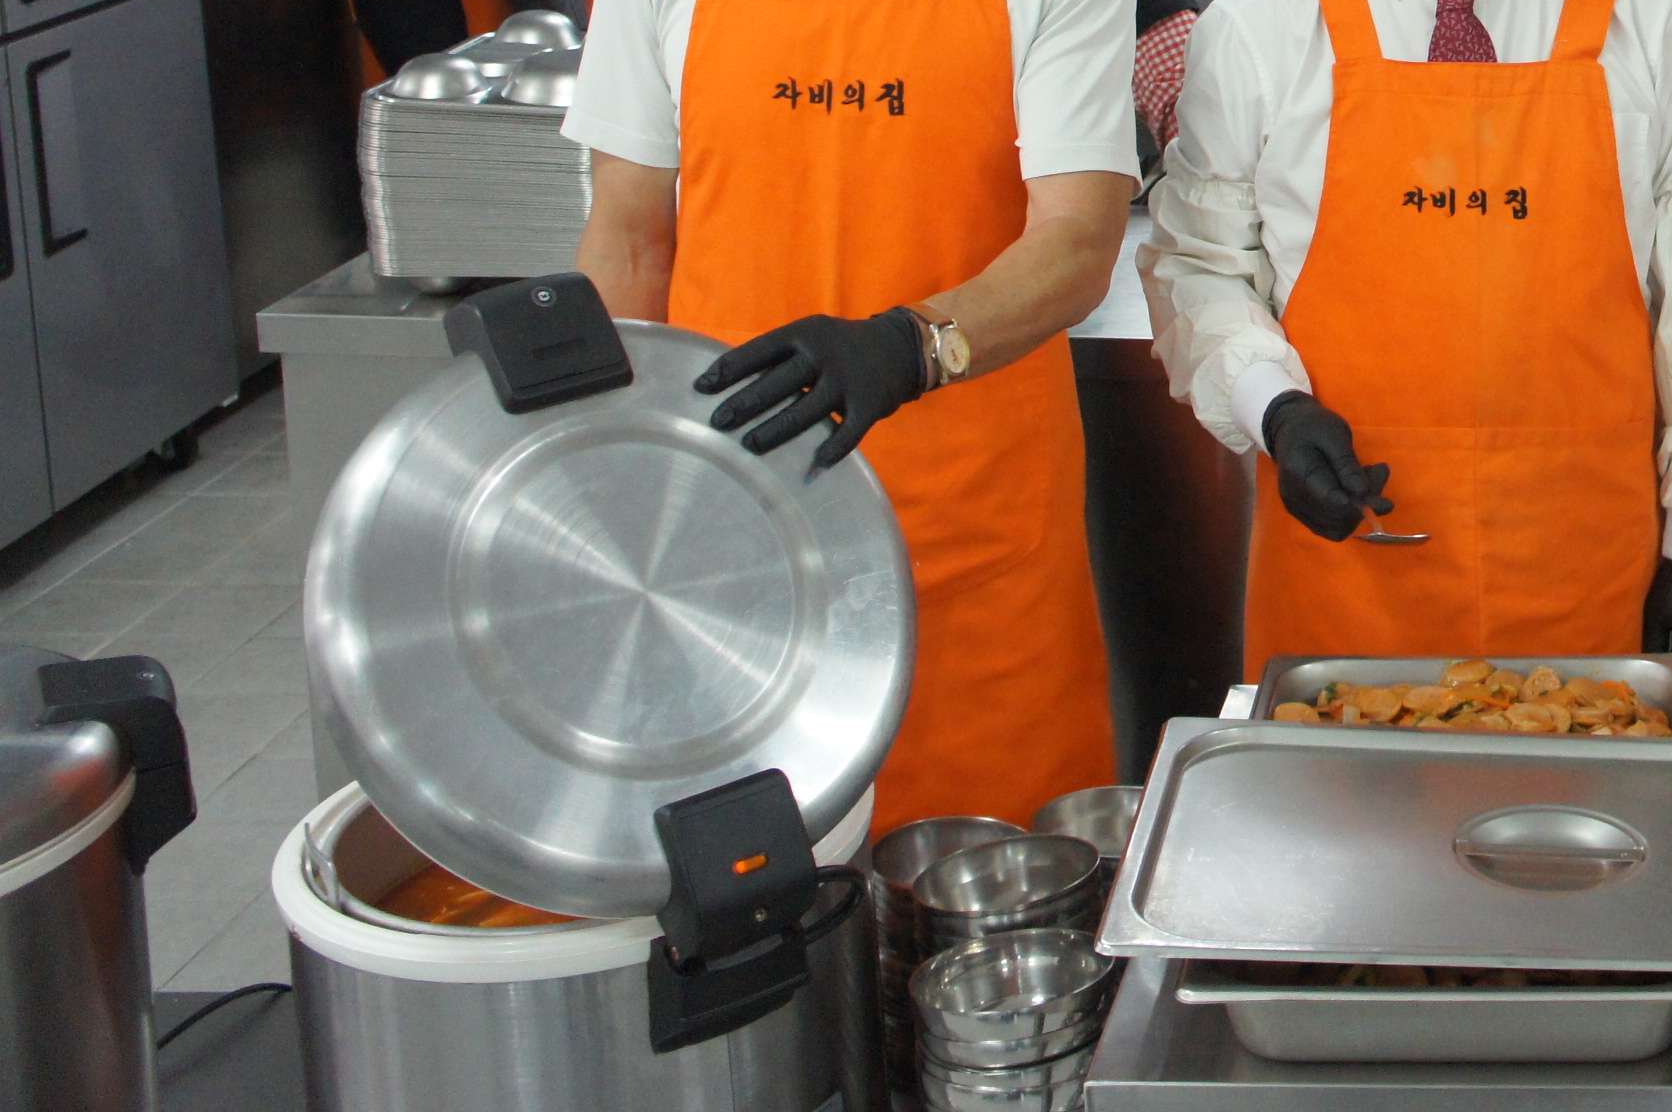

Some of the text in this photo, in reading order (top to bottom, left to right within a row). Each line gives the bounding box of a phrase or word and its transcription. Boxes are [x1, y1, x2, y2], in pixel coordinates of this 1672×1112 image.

[772, 76, 906, 116] 자비의 집
[1402, 186, 1529, 220] 자비의 집
